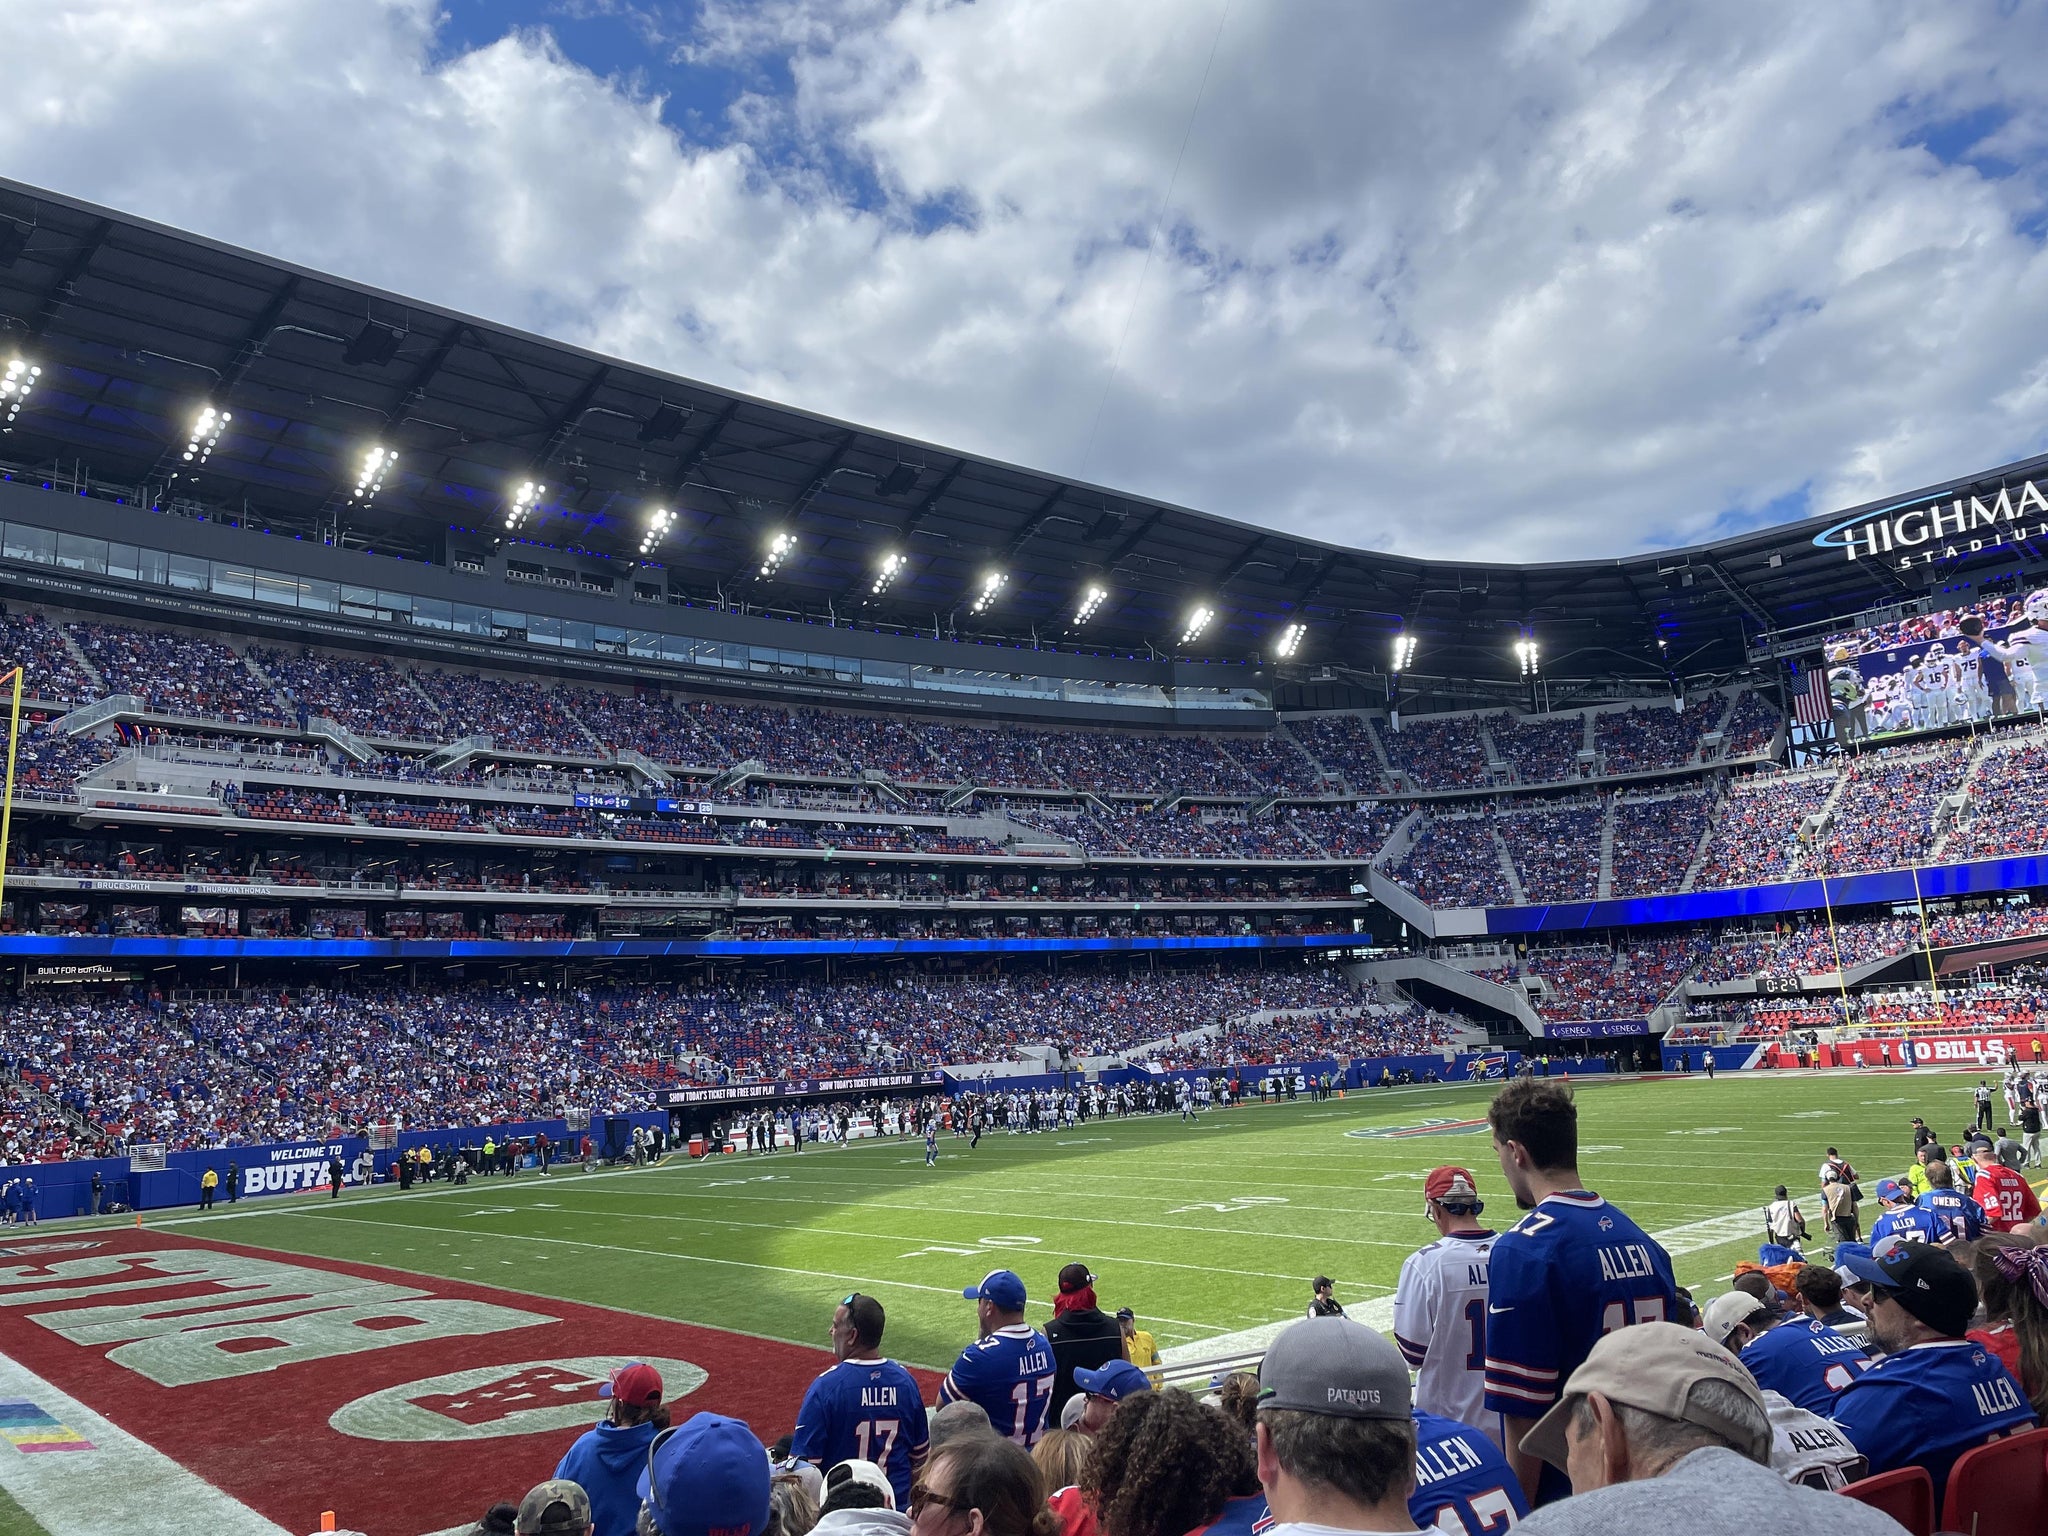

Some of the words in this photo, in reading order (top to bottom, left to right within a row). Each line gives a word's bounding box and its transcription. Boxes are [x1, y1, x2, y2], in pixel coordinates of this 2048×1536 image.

[45, 580, 81, 590] STRATTON
[103, 590, 138, 600] FERGUSON
[1961, 659, 1977, 673] 75
[594, 797, 603, 805] 14
[78, 880, 93, 889] 78
[97, 881, 124, 889] BRUCE
[125, 882, 150, 890] SMITH
[184, 884, 199, 893] 34
[202, 885, 239, 894] THURMAN
[240, 886, 271, 895] THOMAS
[38, 967, 59, 975] BUILT
[61, 966, 77, 975] FOR
[1766, 979, 1798, 993] 0:29
[1560, 1026, 1592, 1035] SENECA
[1611, 1024, 1642, 1033] SENECA
[1934, 1039, 2006, 1060] BILLS
[819, 1081, 833, 1091] SHOW
[834, 1080, 853, 1090] TODAY'S
[853, 1078, 869, 1088] TICKET
[870, 1077, 878, 1087] FOR
[879, 1077, 889, 1086] FREE
[890, 1076, 901, 1085] SLOT
[901, 1075, 912, 1084] PLAY
[669, 1091, 685, 1103] SHOW
[686, 1090, 708, 1102] TODAY'S
[708, 1088, 726, 1100] TICKET
[726, 1088, 736, 1099] FOR
[737, 1087, 749, 1098] FREE
[750, 1086, 762, 1097] SLOT
[762, 1085, 775, 1096] PLAY
[271, 1146, 325, 1161] WELCOME
[328, 1145, 343, 1156] TO
[1932, 1196, 1961, 1208] OWENS
[1984, 1196, 1999, 1210] 22
[2000, 1191, 2023, 1222] 22
[1891, 1217, 1916, 1232] ALLEN
[1597, 1244, 1654, 1282] ALLEN
[1019, 1350, 1048, 1376] ALLEN
[861, 1387, 897, 1407] ALLEN
[1328, 1387, 1381, 1404] PATRIOTS
[1971, 1376, 2021, 1417] ALLEN
[1007, 1373, 1055, 1447] 17
[855, 1419, 900, 1476] 17
[1787, 1428, 1846, 1453] ALLEN
[1414, 1436, 1482, 1487] ALLEN
